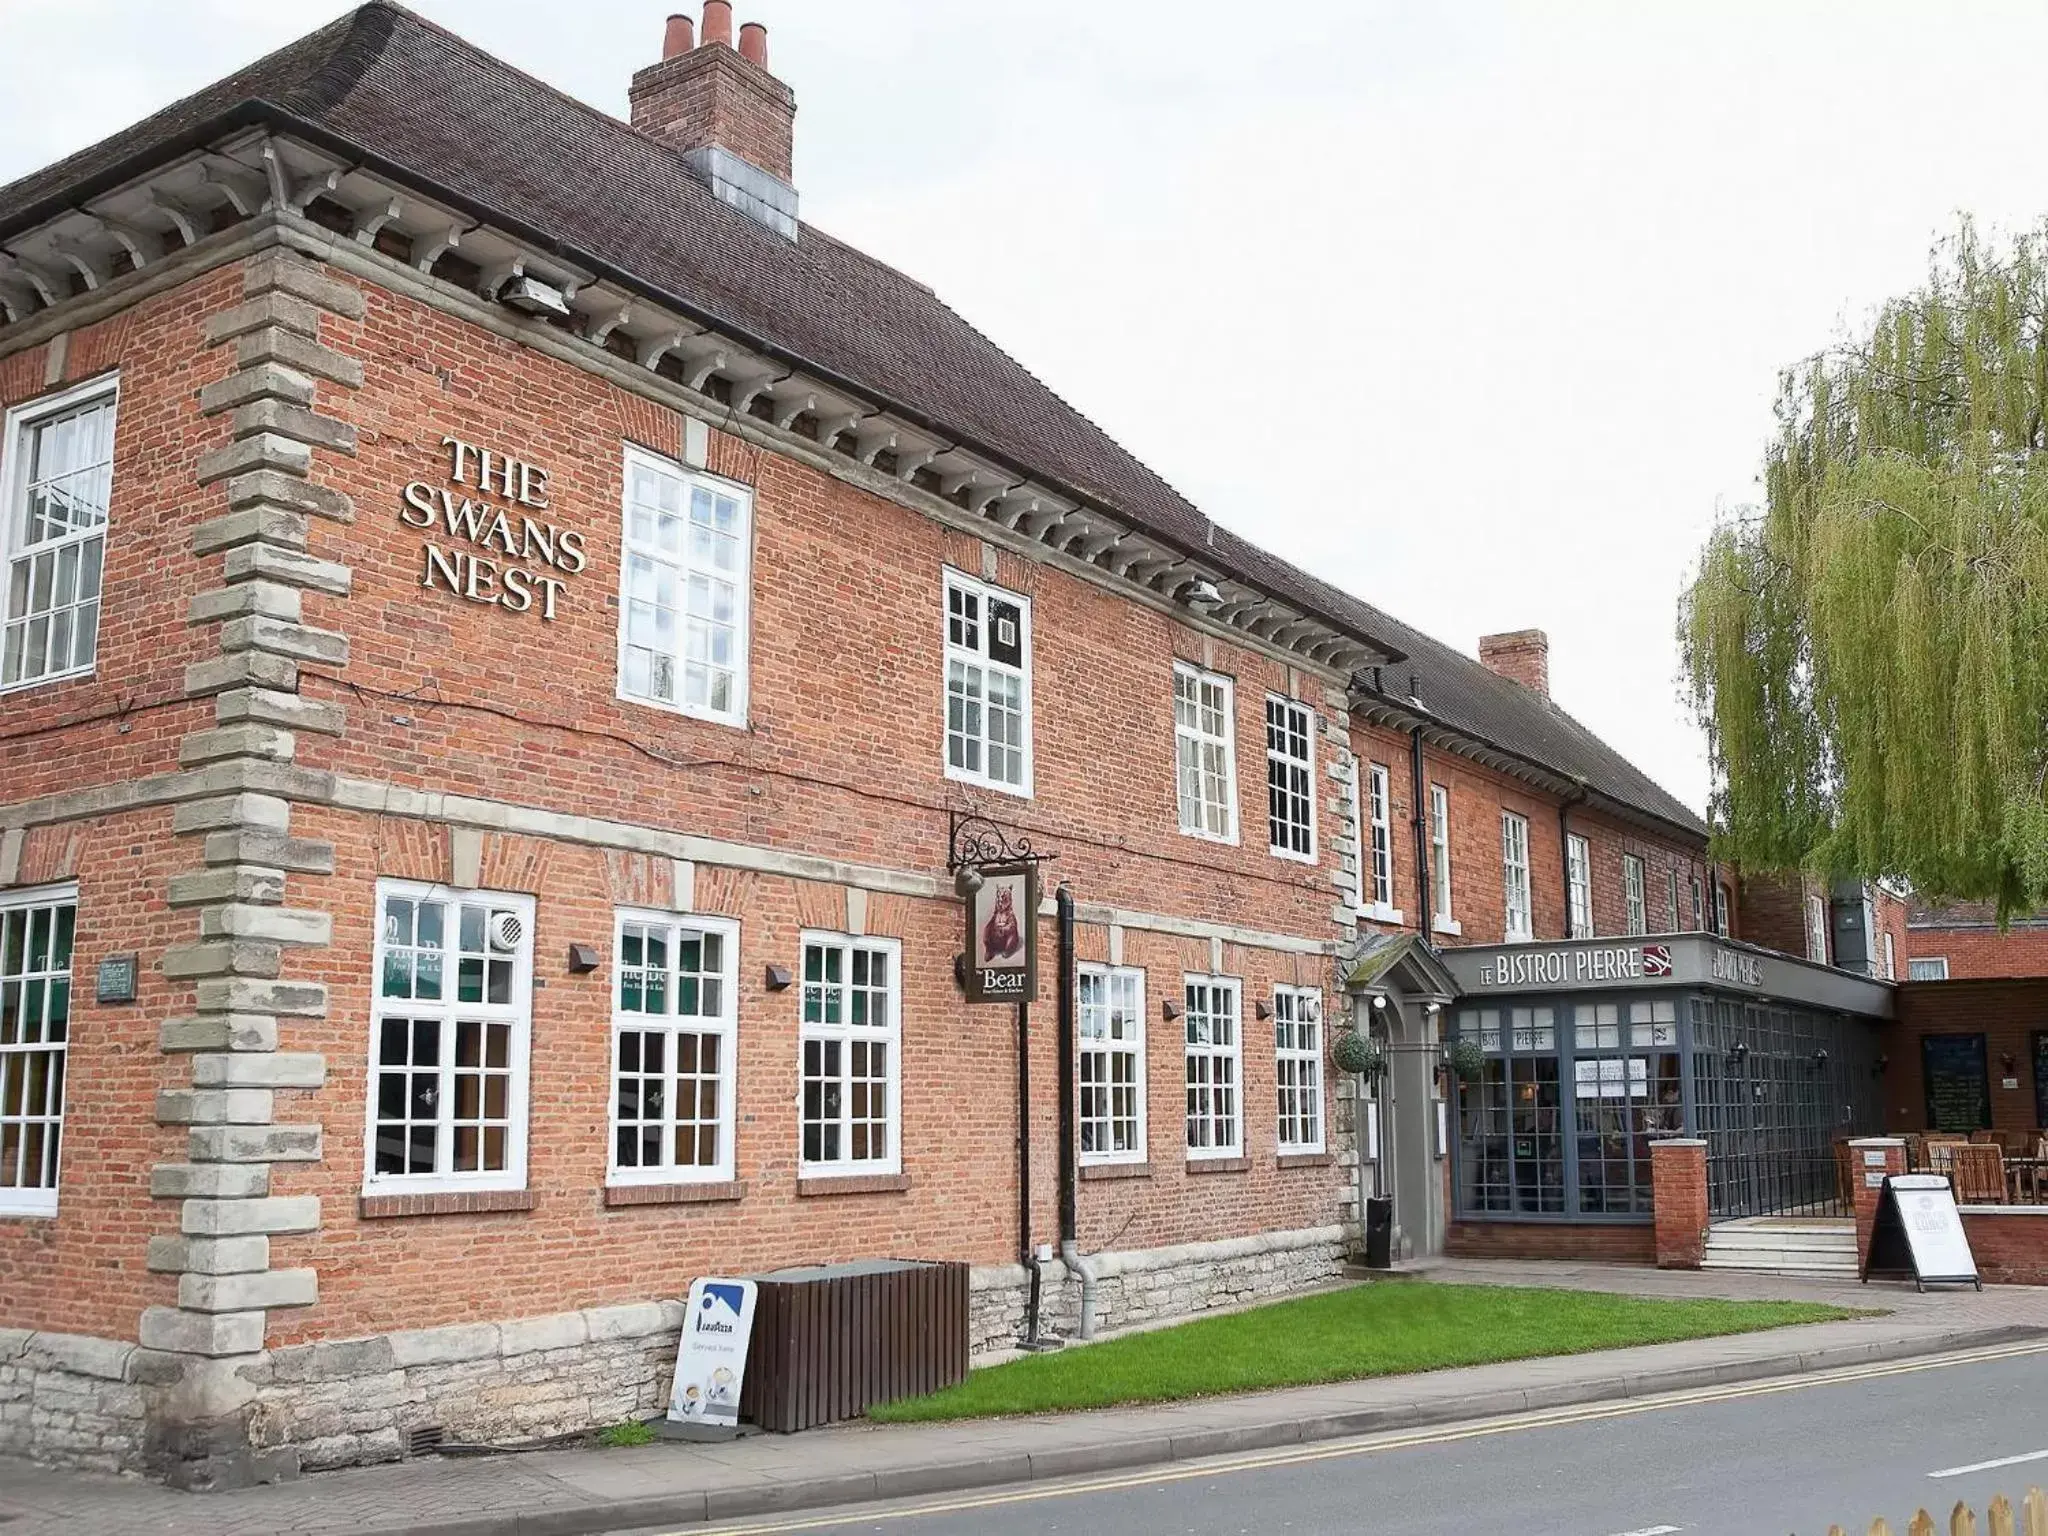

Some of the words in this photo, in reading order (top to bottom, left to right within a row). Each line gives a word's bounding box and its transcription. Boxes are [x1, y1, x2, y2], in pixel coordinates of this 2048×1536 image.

[442, 436, 550, 509] THE
[401, 480, 588, 574] SWANS
[422, 543, 567, 620] NEST
[983, 968, 1026, 988] Bear
[1480, 966, 1493, 986] LE
[1496, 951, 1569, 985] BISTROT
[1575, 948, 1641, 981] PIERRE
